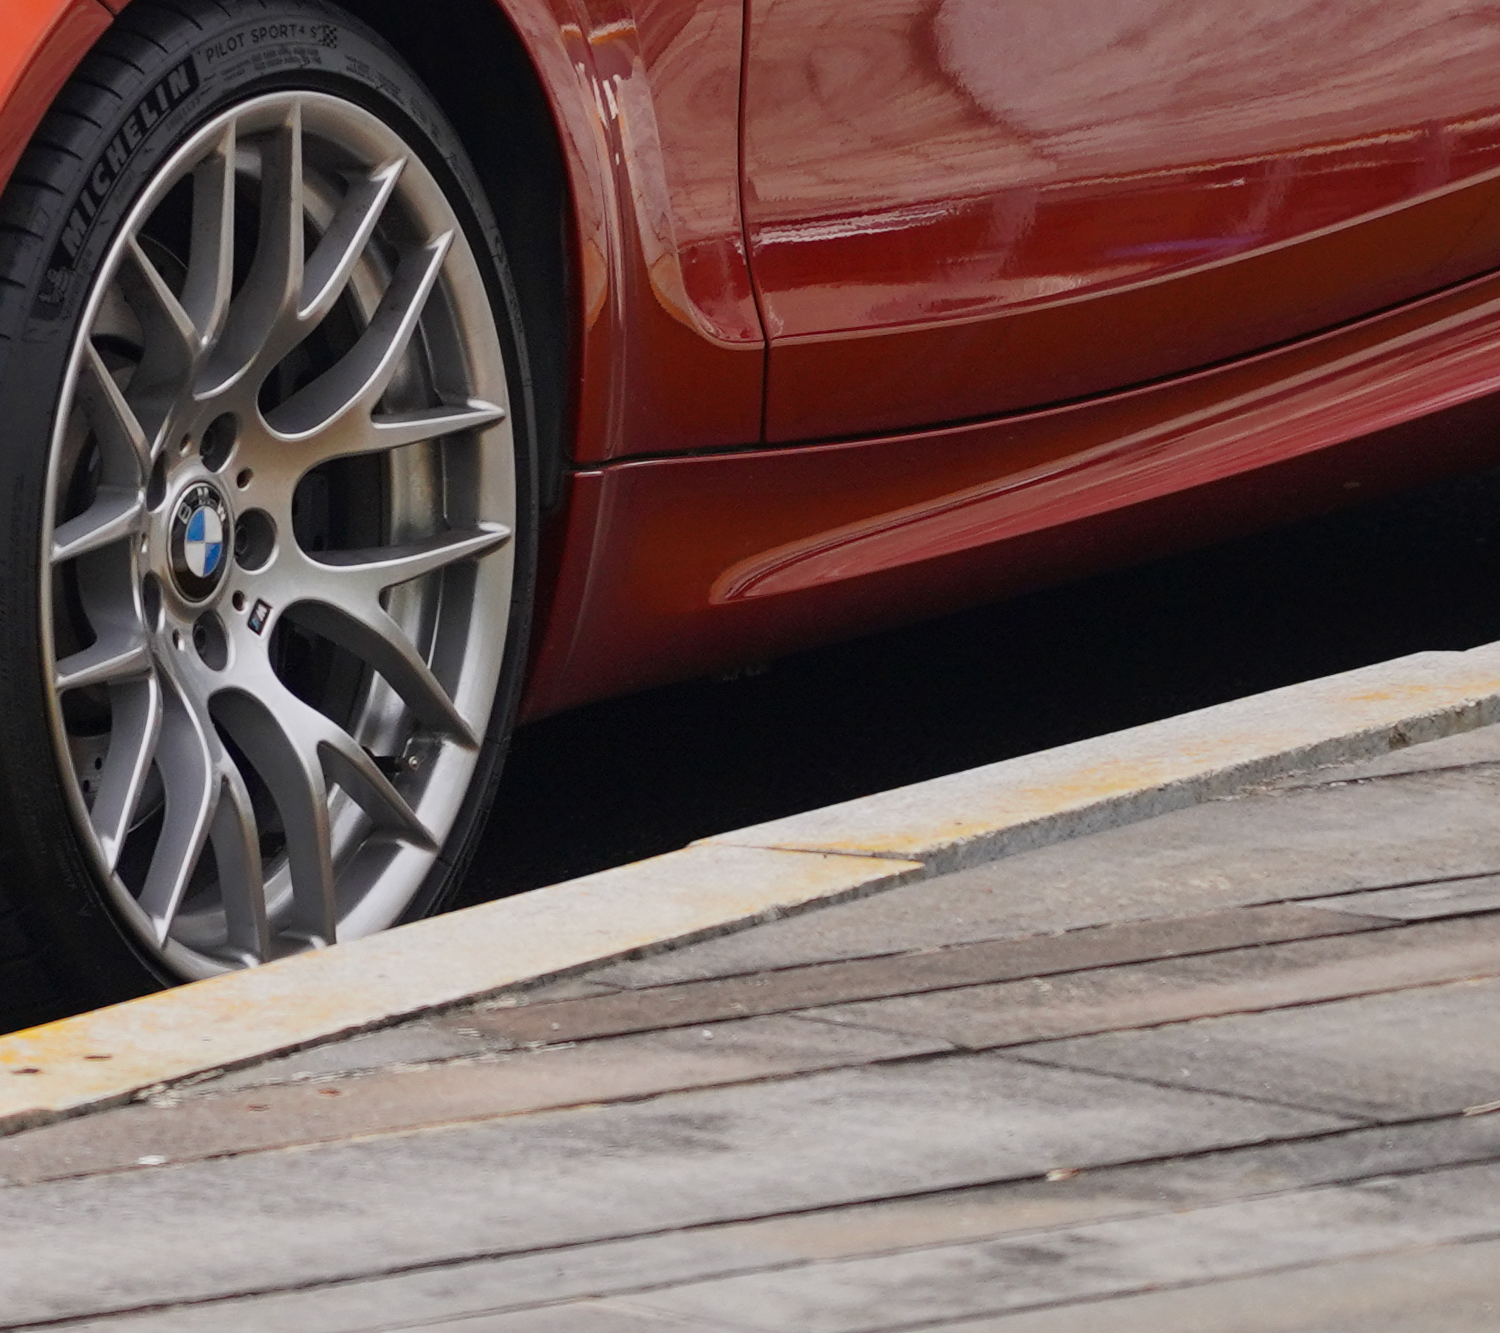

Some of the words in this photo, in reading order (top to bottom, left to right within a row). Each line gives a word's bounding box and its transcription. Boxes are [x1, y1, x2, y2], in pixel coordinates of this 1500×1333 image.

[206, 33, 244, 63] PILOT
[251, 24, 298, 43] SPORT
[61, 64, 192, 258] MICHELIN
[177, 486, 226, 524] BMW
